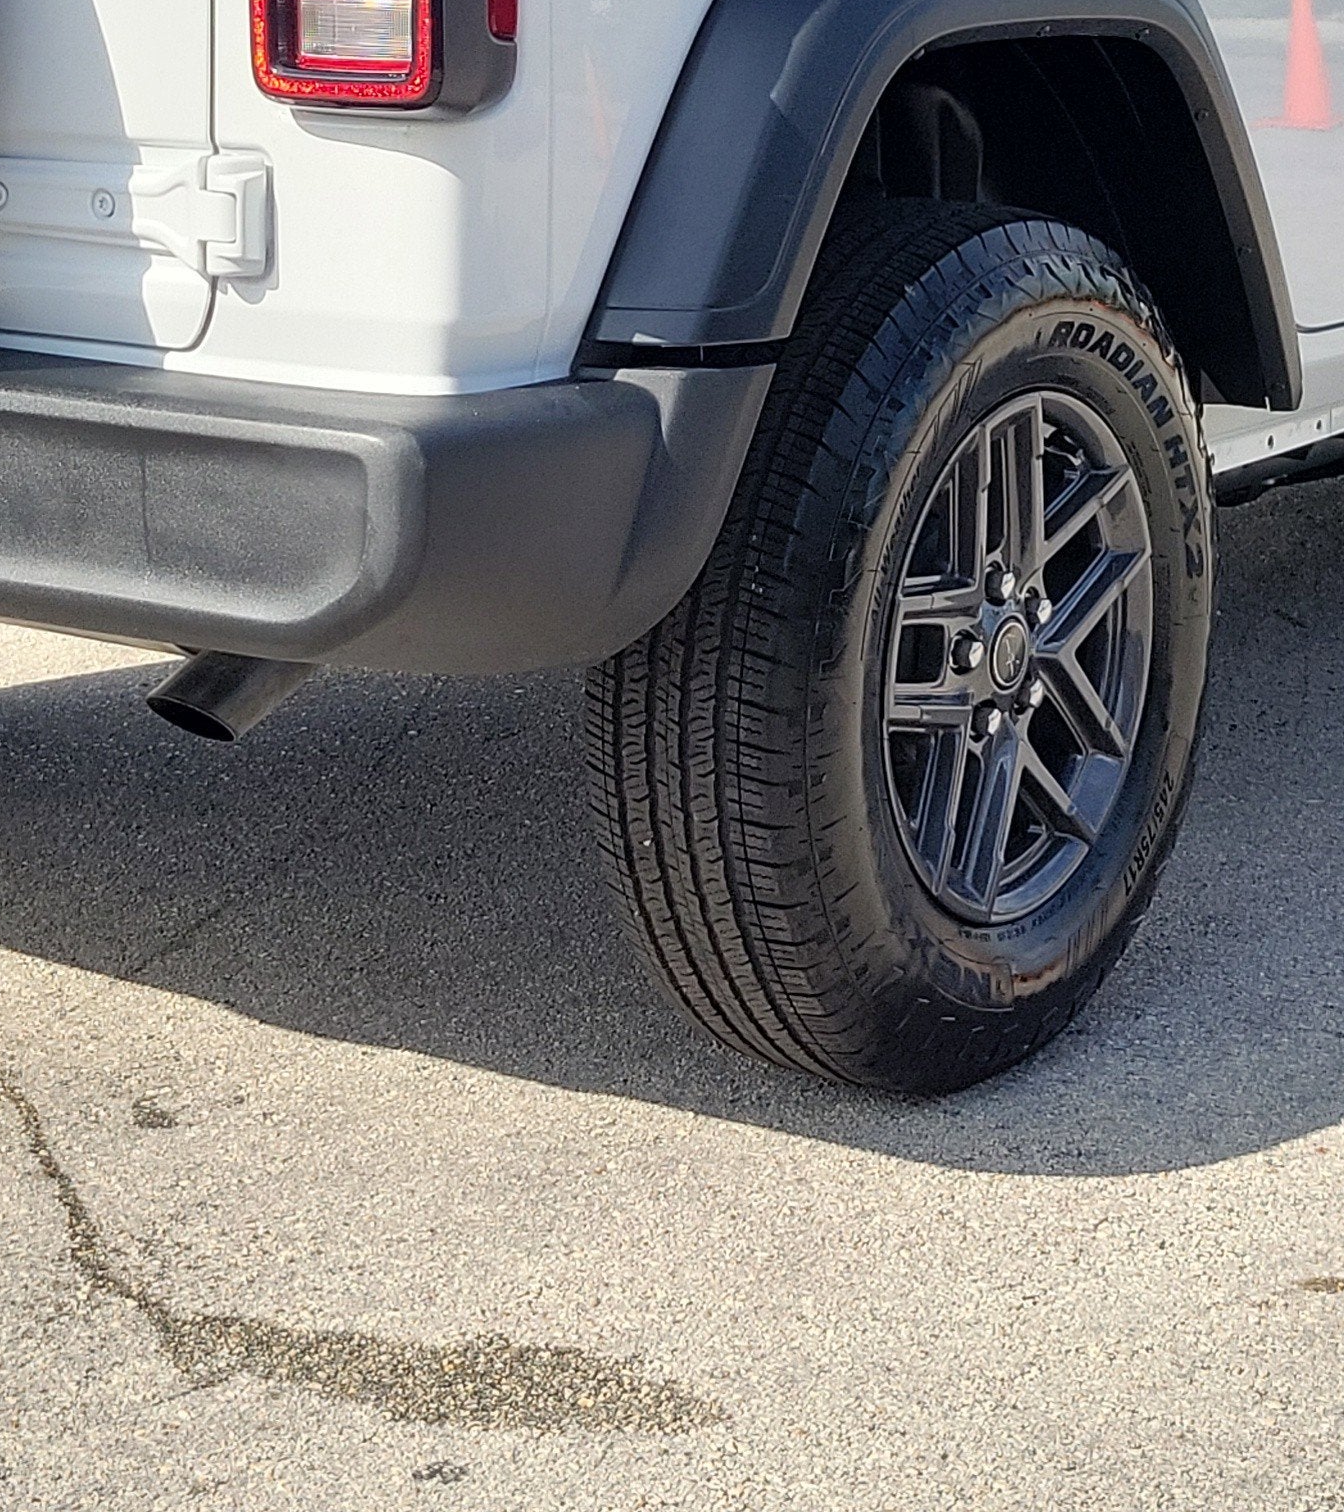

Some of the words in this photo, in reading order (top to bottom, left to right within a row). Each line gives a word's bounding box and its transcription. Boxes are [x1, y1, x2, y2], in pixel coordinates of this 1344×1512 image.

[1048, 320, 1175, 429] ROADIAN
[1164, 434, 1204, 579] HTX2
[1123, 769, 1175, 897] 245/75R17
